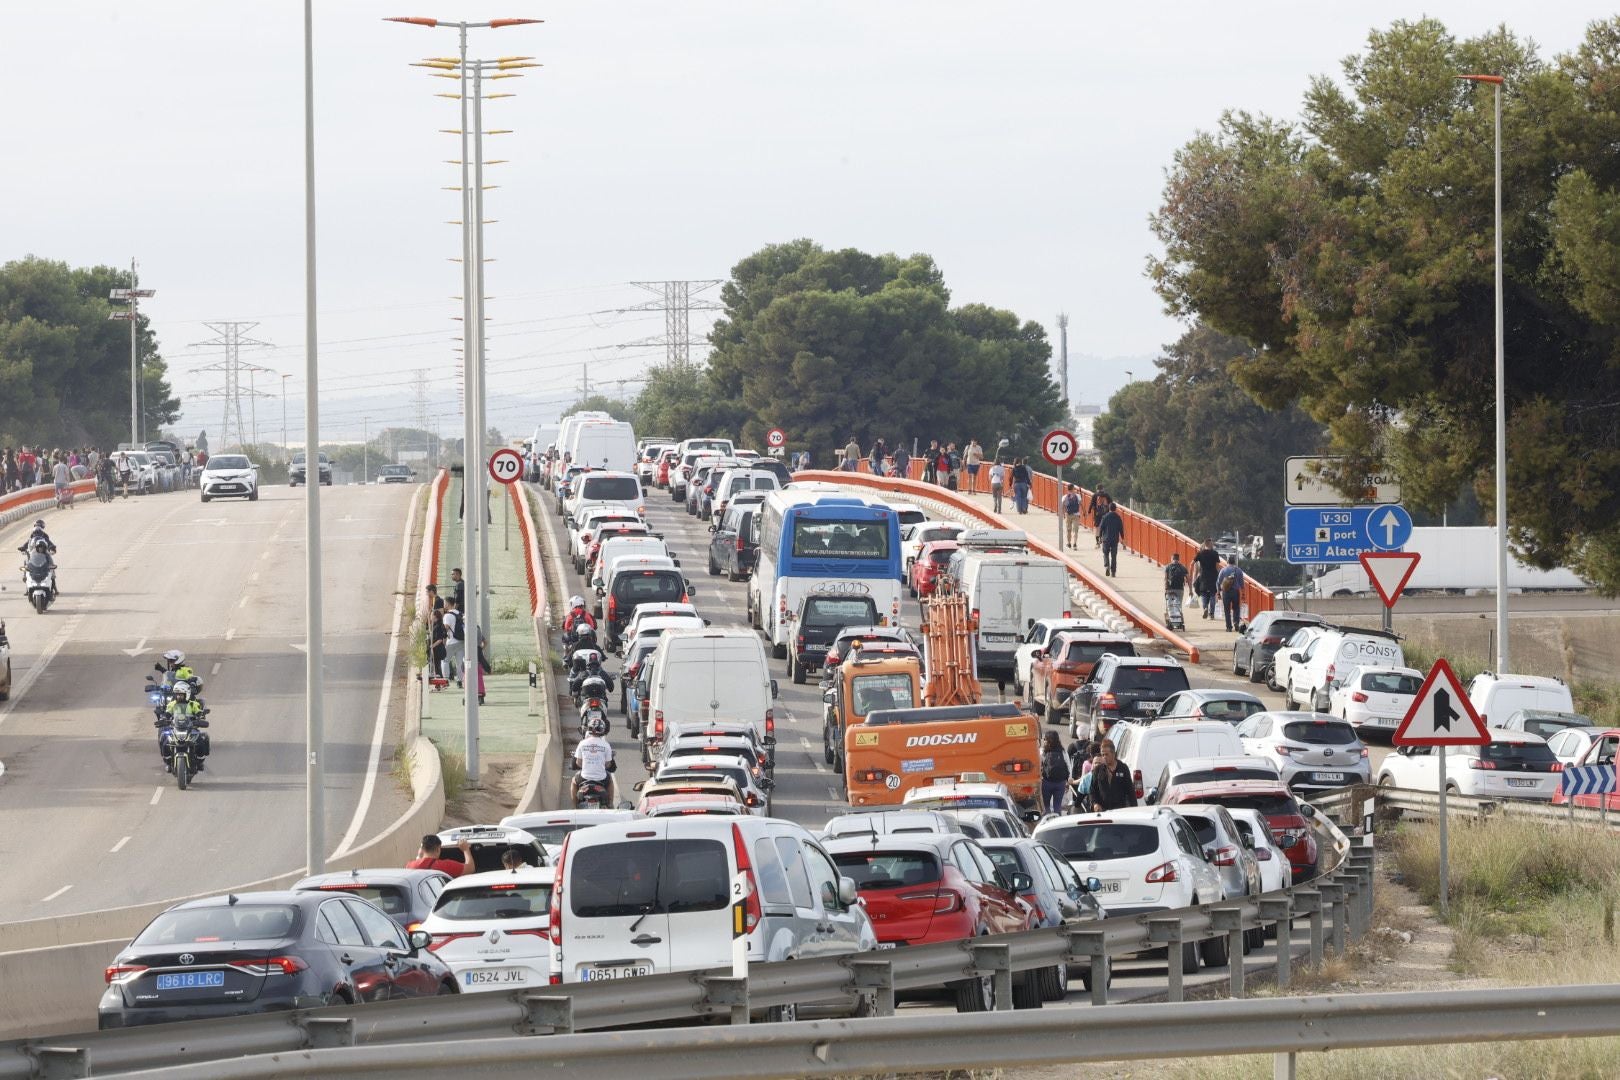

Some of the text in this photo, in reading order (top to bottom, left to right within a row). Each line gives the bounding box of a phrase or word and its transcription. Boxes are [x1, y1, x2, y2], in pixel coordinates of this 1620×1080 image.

[772, 434, 782, 442] 70
[1050, 441, 1069, 454] 70
[496, 460, 516, 473] 70
[1322, 514, 1349, 524] V-30
[1333, 530, 1357, 541] port
[1294, 547, 1317, 556] V-31
[1359, 644, 1397, 657] FONSY
[906, 732, 978, 748] DOOSAN
[888, 775, 899, 788] 20
[734, 882, 742, 895] 2
[165, 972, 222, 987] 9618 LRC
[472, 970, 525, 983] 0524 JVL
[589, 968, 617, 981] 0651
